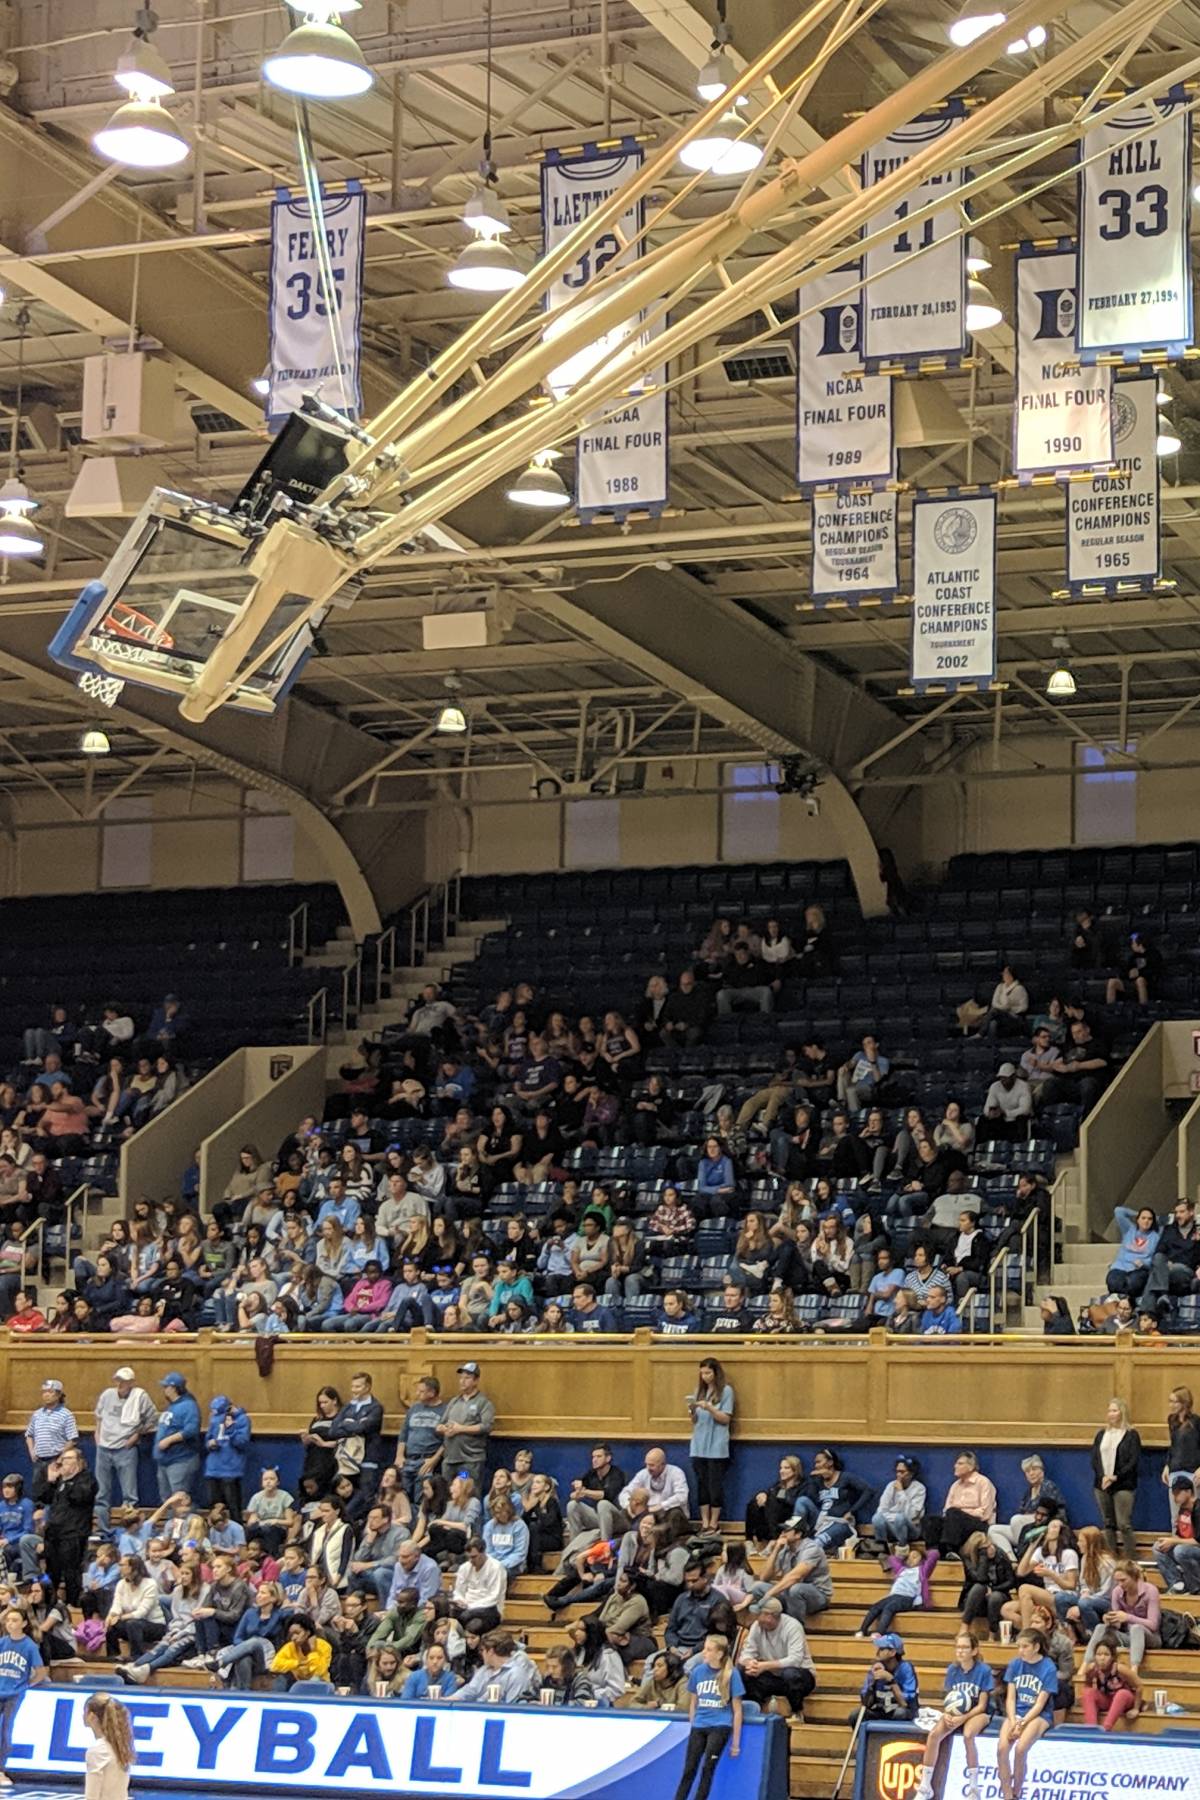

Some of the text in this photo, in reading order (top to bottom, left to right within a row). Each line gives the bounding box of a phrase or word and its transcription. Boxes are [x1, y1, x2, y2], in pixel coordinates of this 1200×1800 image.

[1108, 140, 1161, 176] HILL
[554, 187, 634, 226] LAETT
[1098, 184, 1169, 241] 33
[893, 199, 936, 253] 11
[286, 268, 345, 320] 35
[1088, 291, 1137, 311] FEBRUARY
[871, 304, 918, 321] FEBRUARY
[1042, 364, 1081, 381] NCAA
[826, 378, 863, 396] NCAA
[1021, 389, 1106, 411] FINAL FOUR
[804, 404, 886, 426] FINAL FOUR
[583, 431, 662, 454] FINAL FOUR
[1044, 436, 1082, 454] 1990
[827, 450, 862, 467] 1989
[606, 476, 639, 494] 1988
[1092, 477, 1133, 493] COAST
[836, 494, 873, 509] COAST
[1072, 492, 1154, 514] CONFERENCE
[817, 509, 893, 528] CONFERENCE
[1075, 512, 1151, 531] CHAMPIONS
[819, 527, 889, 546] CHAMPIONS
[1081, 533, 1144, 548] REGULAR SEASON
[1095, 552, 1130, 568] 1965
[837, 568, 870, 582] 1964
[927, 569, 980, 585] ATLANTIC
[935, 587, 973, 601] COAST
[917, 601, 991, 618] CONFERENCE
[920, 618, 988, 635] CHAMPIONS
[936, 655, 969, 669] 2002
[696, 1680, 722, 1696] DUK
[1032, 1769, 1109, 1787] LOGISTICS
[1111, 1773, 1189, 1791] COMPANY
[1030, 1788, 1109, 1800] ATHLETICS
